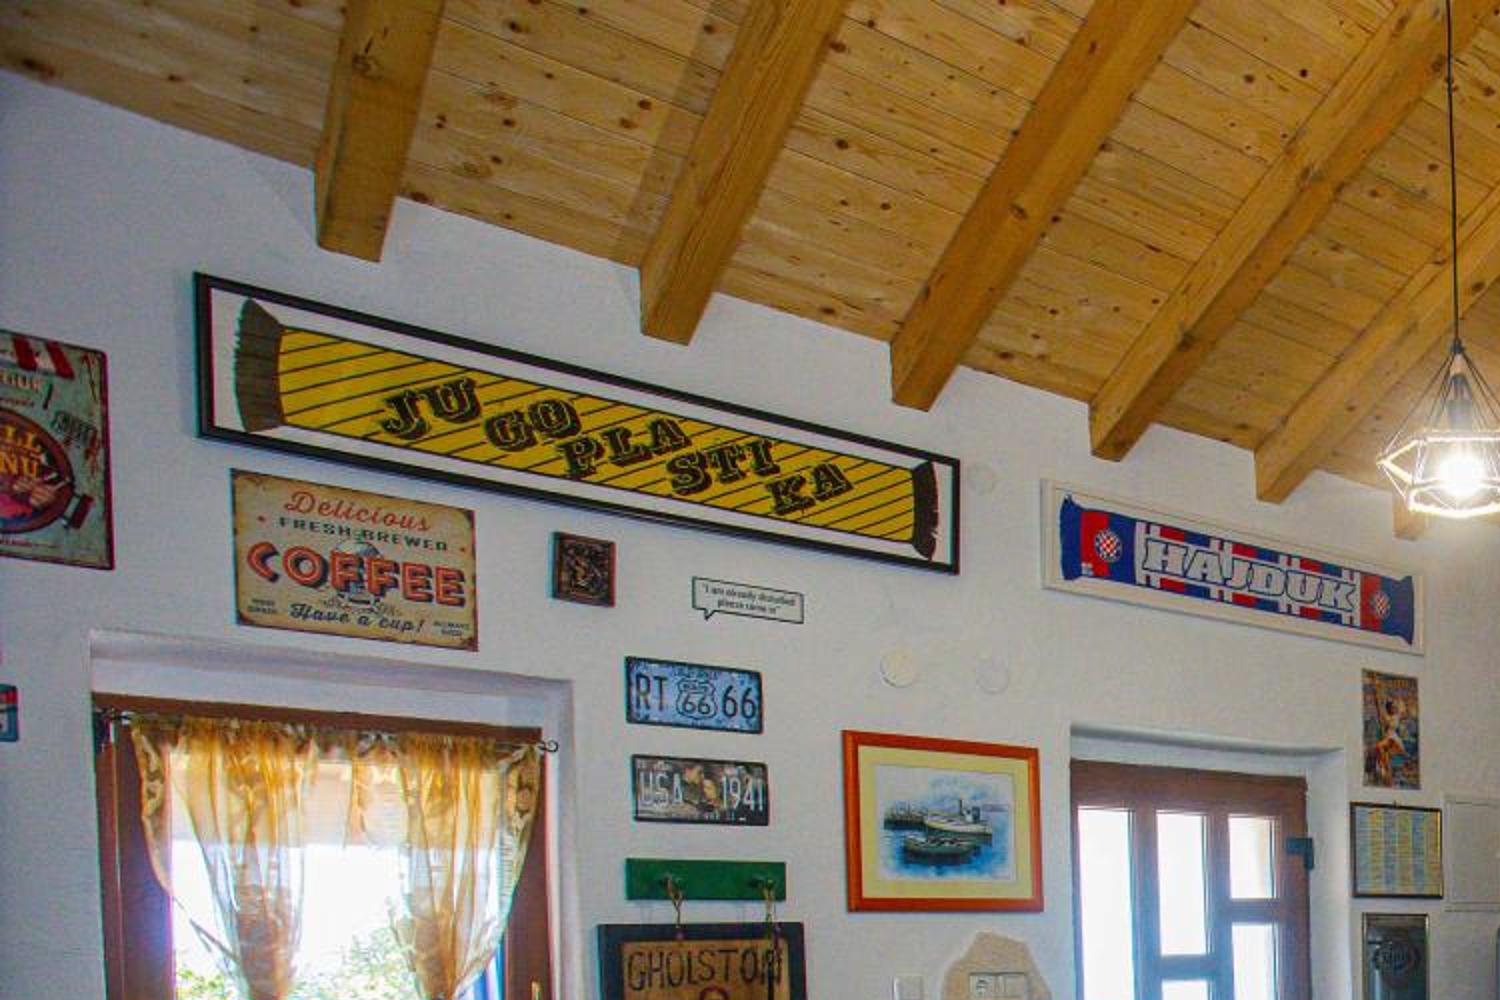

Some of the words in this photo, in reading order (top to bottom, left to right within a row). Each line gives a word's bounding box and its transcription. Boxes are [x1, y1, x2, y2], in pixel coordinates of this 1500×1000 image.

[284, 491, 431, 531] Delicious
[247, 541, 466, 608] COFFEE
[1141, 537, 1358, 613] HAJDUK
[288, 602, 350, 625] Have
[356, 614, 373, 626] a
[378, 616, 425, 634] cup!
[634, 672, 668, 712] RT
[683, 692, 712, 715] 66
[722, 684, 757, 719] 66
[638, 770, 684, 807] USA
[721, 773, 765, 812] 1941
